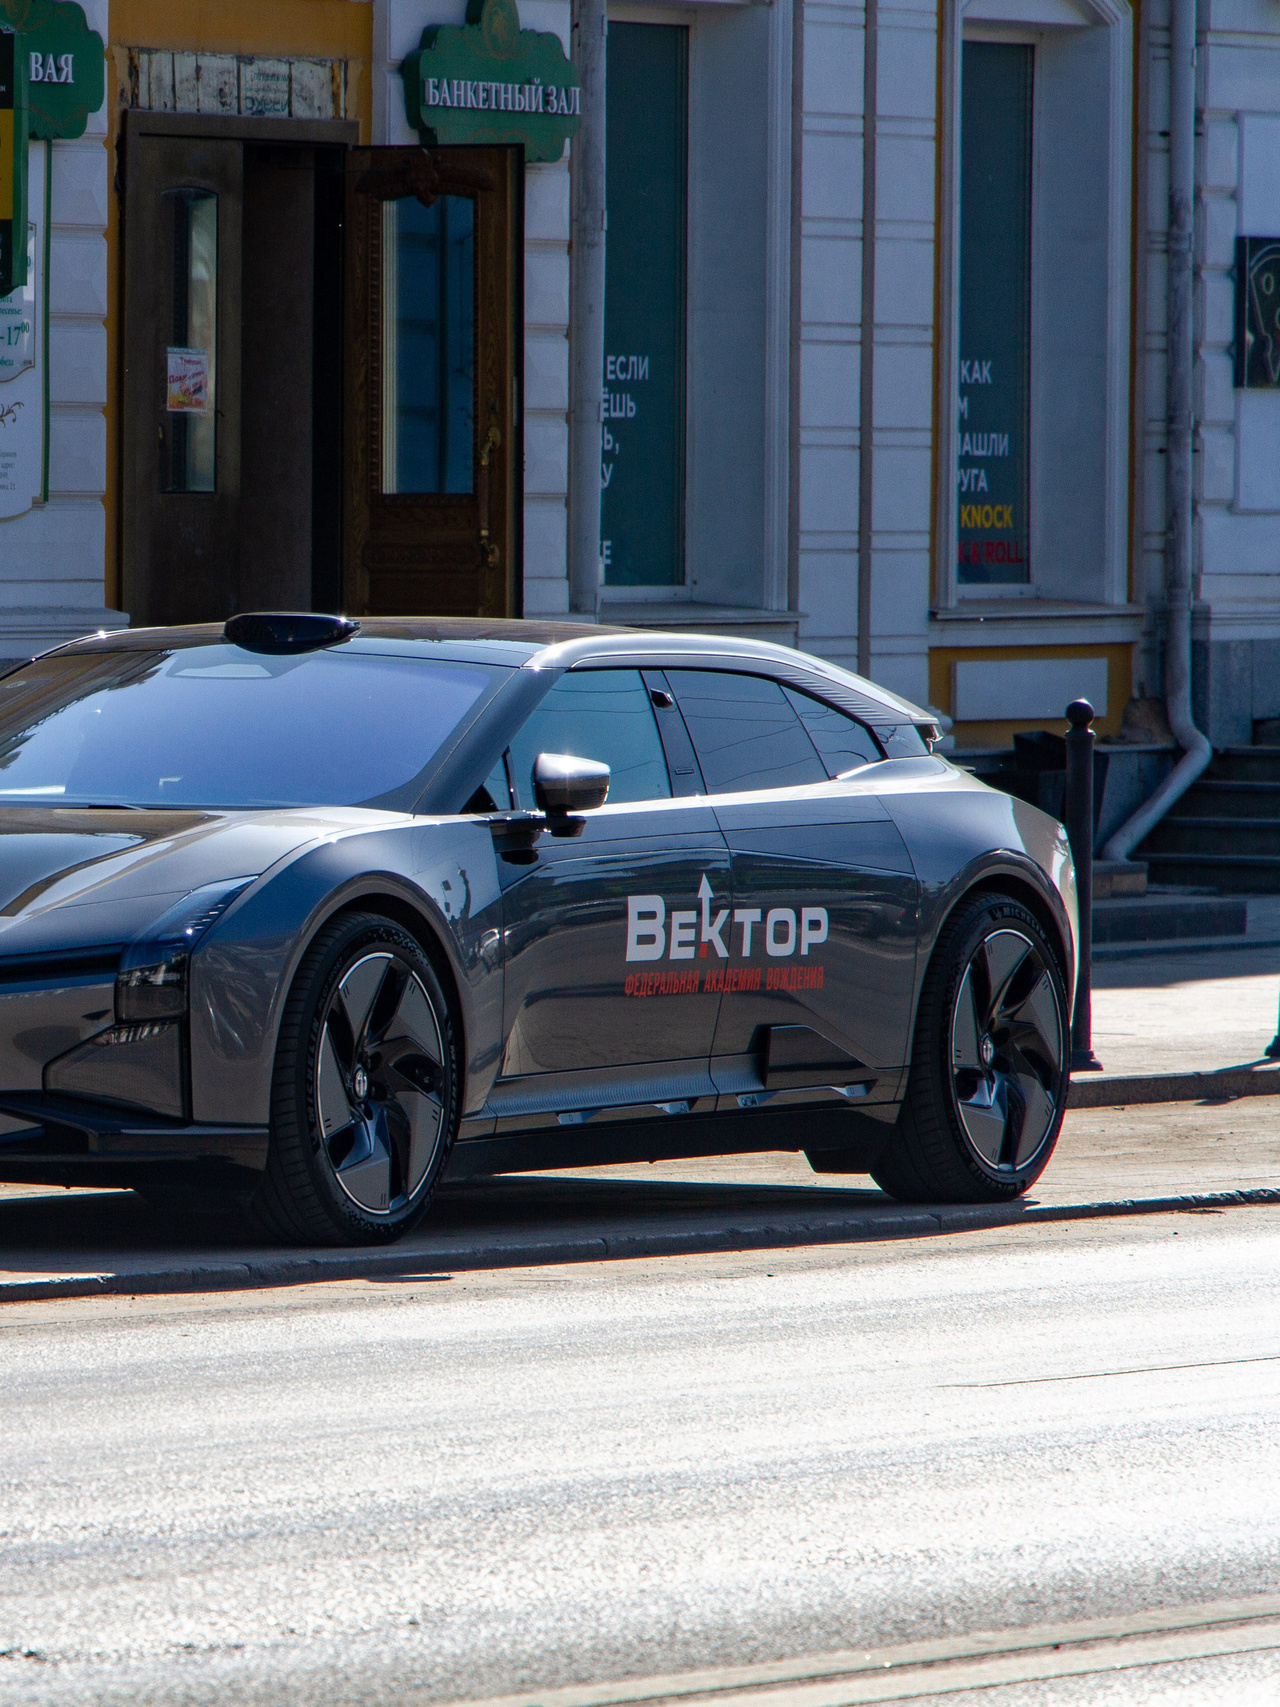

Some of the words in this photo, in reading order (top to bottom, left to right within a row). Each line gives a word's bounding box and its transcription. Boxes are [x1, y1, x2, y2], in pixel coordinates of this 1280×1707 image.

[29, 52, 75, 83] ВАЯ
[426, 77, 544, 113] БАНКЕТНЫЙ
[547, 85, 581, 115] ЗАЛ
[606, 355, 650, 381] ЕСЛИ
[960, 360, 993, 385] КАК
[601, 387, 637, 418] ЁШЬ
[601, 463, 613, 489] У
[958, 468, 989, 493] УГА
[960, 504, 1013, 529] KNOCK
[601, 540, 612, 565] Е
[970, 541, 980, 564] &
[984, 540, 1023, 565] ROLL
[1003, 906, 1046, 940] MICHELIN
[624, 970, 700, 998] ФЕДЕРАЛЬНАЯ
[703, 967, 762, 994] АКАДЕМИЯ
[765, 966, 825, 992] ВОЖДЕНИЯ
[305, 1017, 320, 1123] MICHELIN
